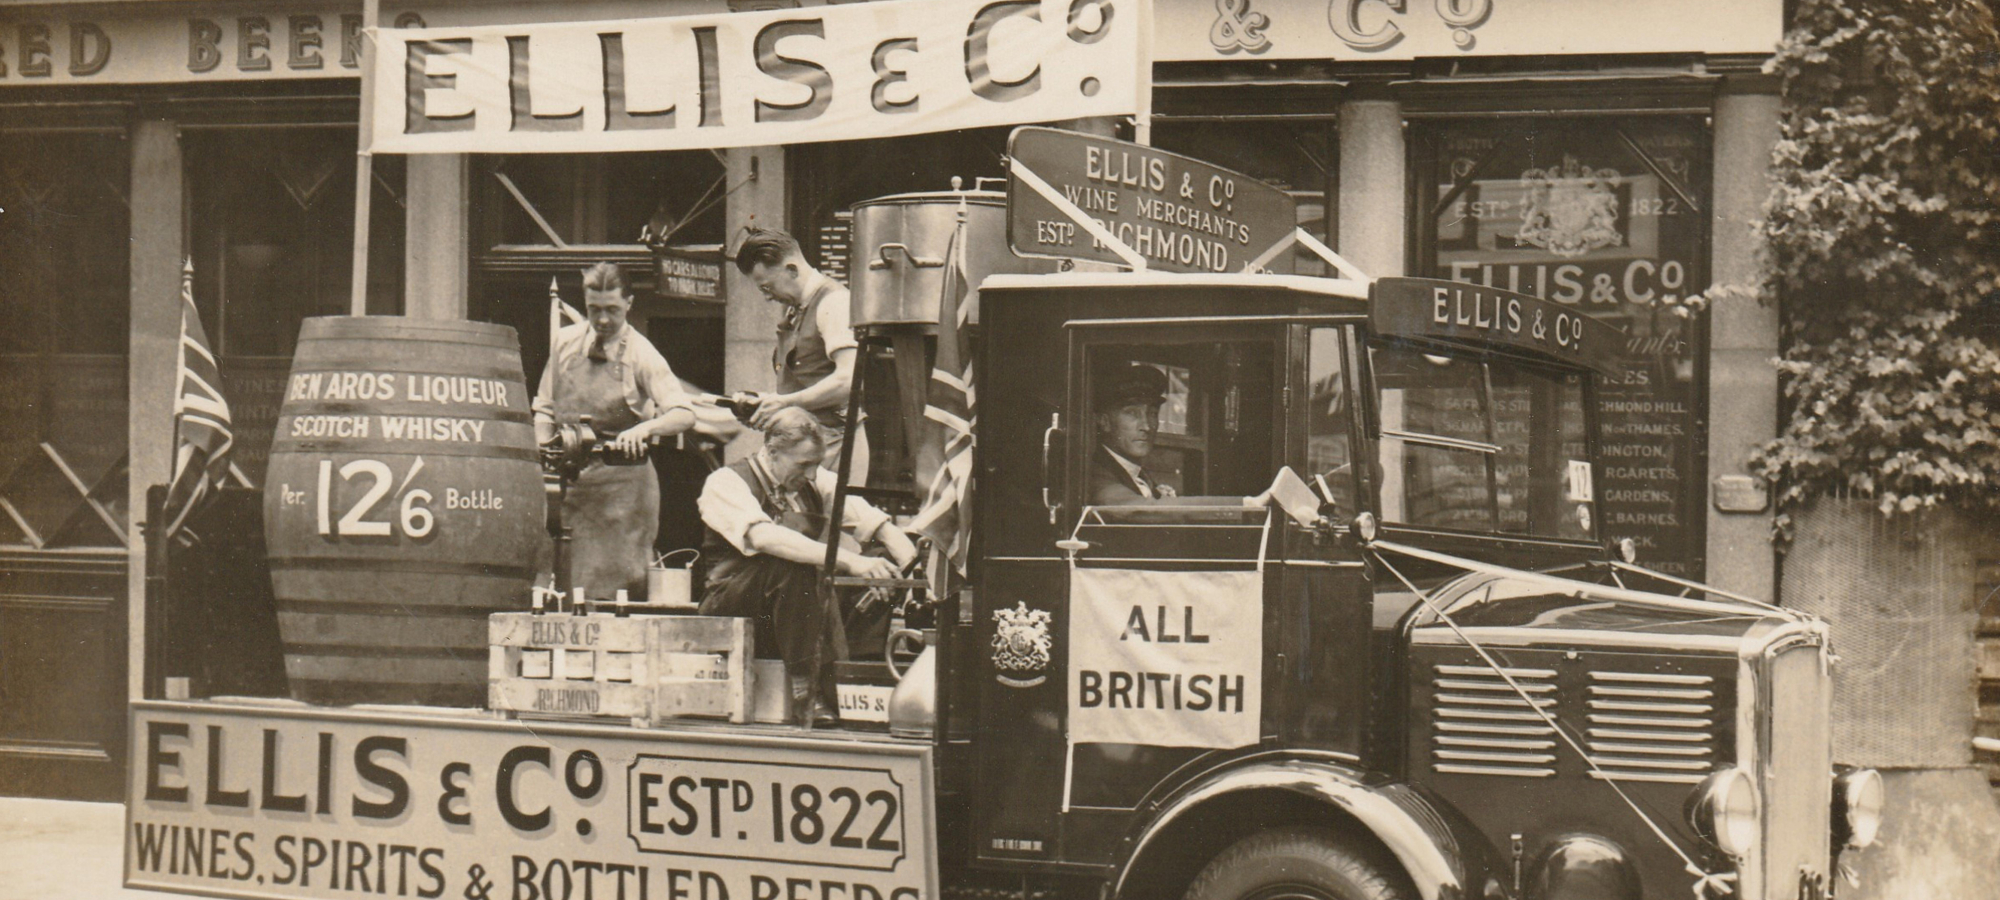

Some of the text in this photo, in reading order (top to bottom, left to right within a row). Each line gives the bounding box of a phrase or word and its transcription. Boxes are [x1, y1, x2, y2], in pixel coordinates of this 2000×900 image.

[0, 12, 427, 77] ED BEER
[1209, 0, 1273, 55] &
[402, 17, 834, 134] ELLIS
[1086, 145, 1166, 192] ELLIS
[1179, 172, 1194, 200] &
[1064, 184, 1250, 245] WINE MERCHANTS
[1589, 273, 1618, 304] &
[1433, 287, 1522, 333] ELLIS
[1532, 308, 1547, 340] &
[290, 372, 508, 407] BEN AROS LIQUEUR
[291, 415, 485, 442] SCOTCH WHISKY
[446, 488, 503, 510] Bottle
[531, 621, 566, 645] ELLIS
[570, 622, 581, 645] &
[1119, 605, 1210, 643] ALL
[538, 688, 600, 713] RICHMOND
[840, 694, 885, 712] LIS &
[1079, 670, 1244, 713] BRITISH
[144, 720, 412, 822] ELLIS
[771, 781, 900, 852] 1822
[136, 822, 265, 886] WINES,
[272, 833, 447, 899] SPIRITS
[463, 862, 497, 900] &
